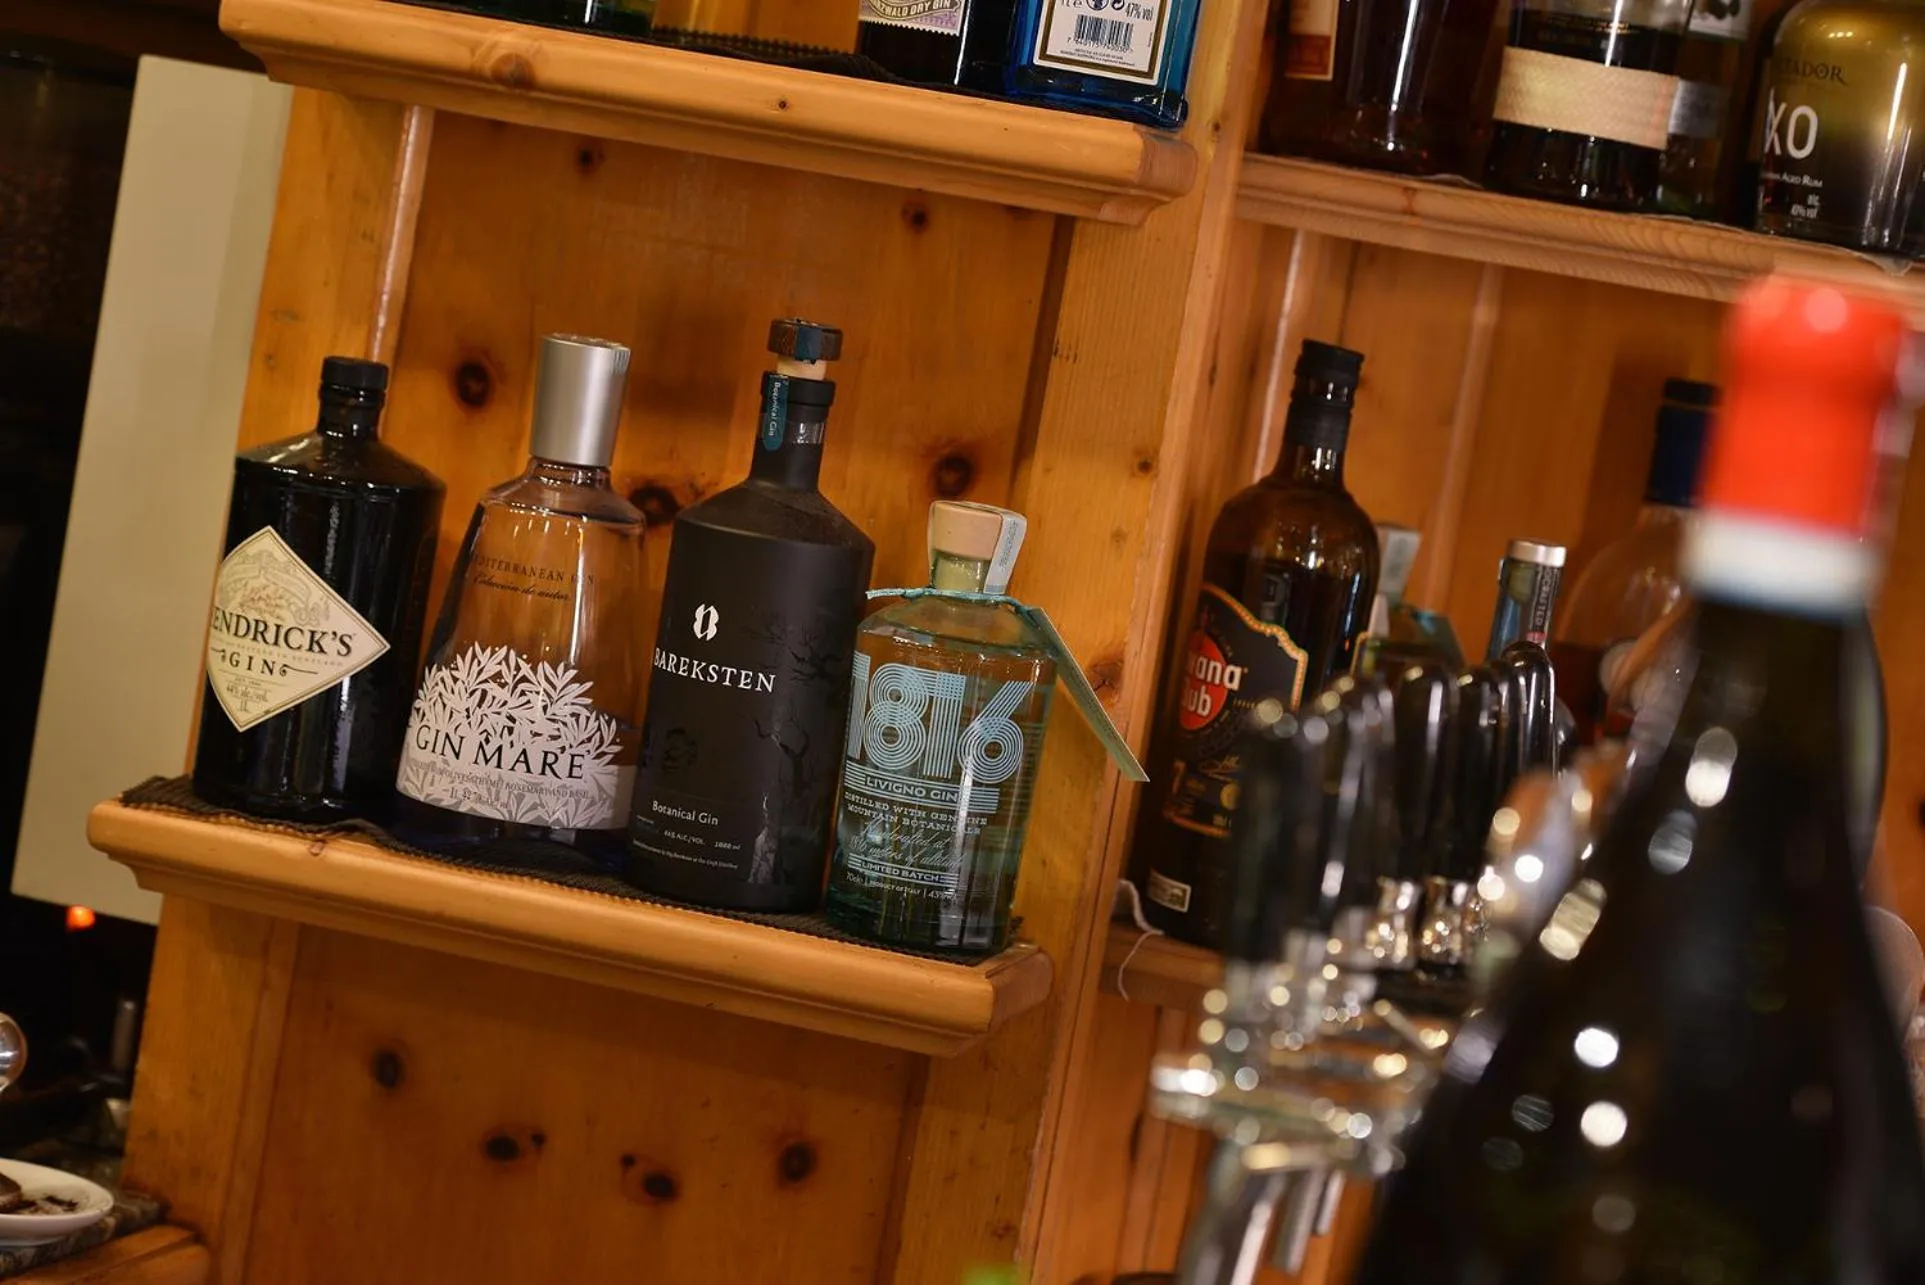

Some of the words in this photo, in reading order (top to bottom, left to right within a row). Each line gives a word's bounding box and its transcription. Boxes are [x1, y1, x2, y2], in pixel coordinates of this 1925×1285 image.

[909, 1, 932, 16] DRY
[1765, 90, 1818, 159] XO
[211, 606, 353, 657] ENDRICK'S
[229, 650, 276, 676] GIN
[653, 647, 777, 693] BAREKSTEN
[846, 650, 1034, 785] 1816
[415, 724, 466, 760] GIN
[471, 742, 586, 781] MARE
[866, 776, 927, 798] LIVIGNO
[930, 790, 960, 803] GIN
[652, 800, 696, 822] Botanical
[698, 811, 719, 826] Gin
[847, 803, 899, 824] MOUNTAIN
[901, 817, 982, 836] BOTANICLS
[892, 805, 928, 818] WITH
[930, 812, 988, 826] GENINE
[861, 860, 901, 876] LIMITED
[900, 869, 940, 881] BATCH
